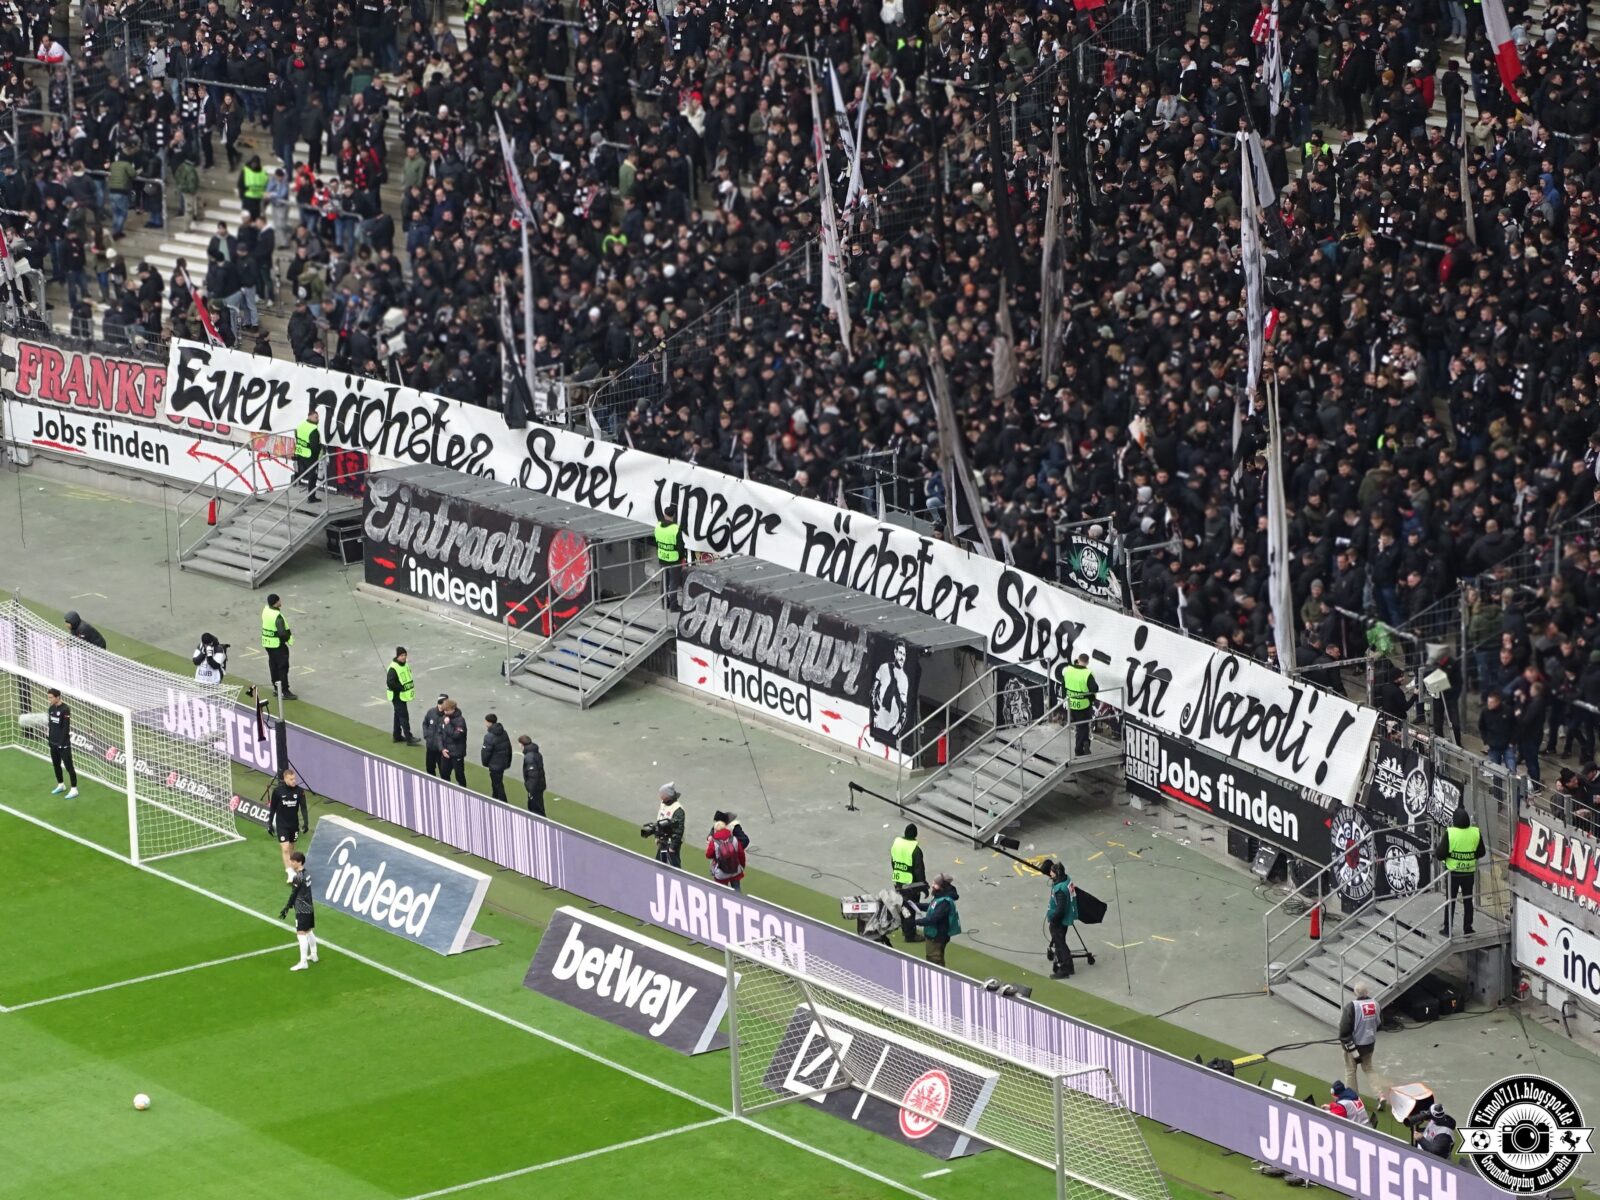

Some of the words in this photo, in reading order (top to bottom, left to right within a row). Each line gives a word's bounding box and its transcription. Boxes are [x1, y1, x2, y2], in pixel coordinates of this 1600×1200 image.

[33, 412, 87, 447] Jobs
[92, 422, 170, 466] finden
[171, 346, 292, 432] Euer
[512, 427, 634, 518] Spiel,
[802, 511, 979, 625] nächster
[990, 570, 1087, 684] Sieg
[1126, 625, 1173, 718] in
[364, 474, 541, 585] Eintracht
[402, 556, 498, 613] indeed
[722, 656, 812, 723] indeed
[1126, 724, 1160, 768] RIED
[1126, 756, 1160, 788] GEBIET
[237, 799, 249, 814] LG
[1160, 749, 1213, 803] Jobs
[1217, 773, 1299, 842] finden
[325, 838, 441, 937] indeed
[650, 873, 806, 977] JARLTECH
[551, 922, 698, 1038] betway
